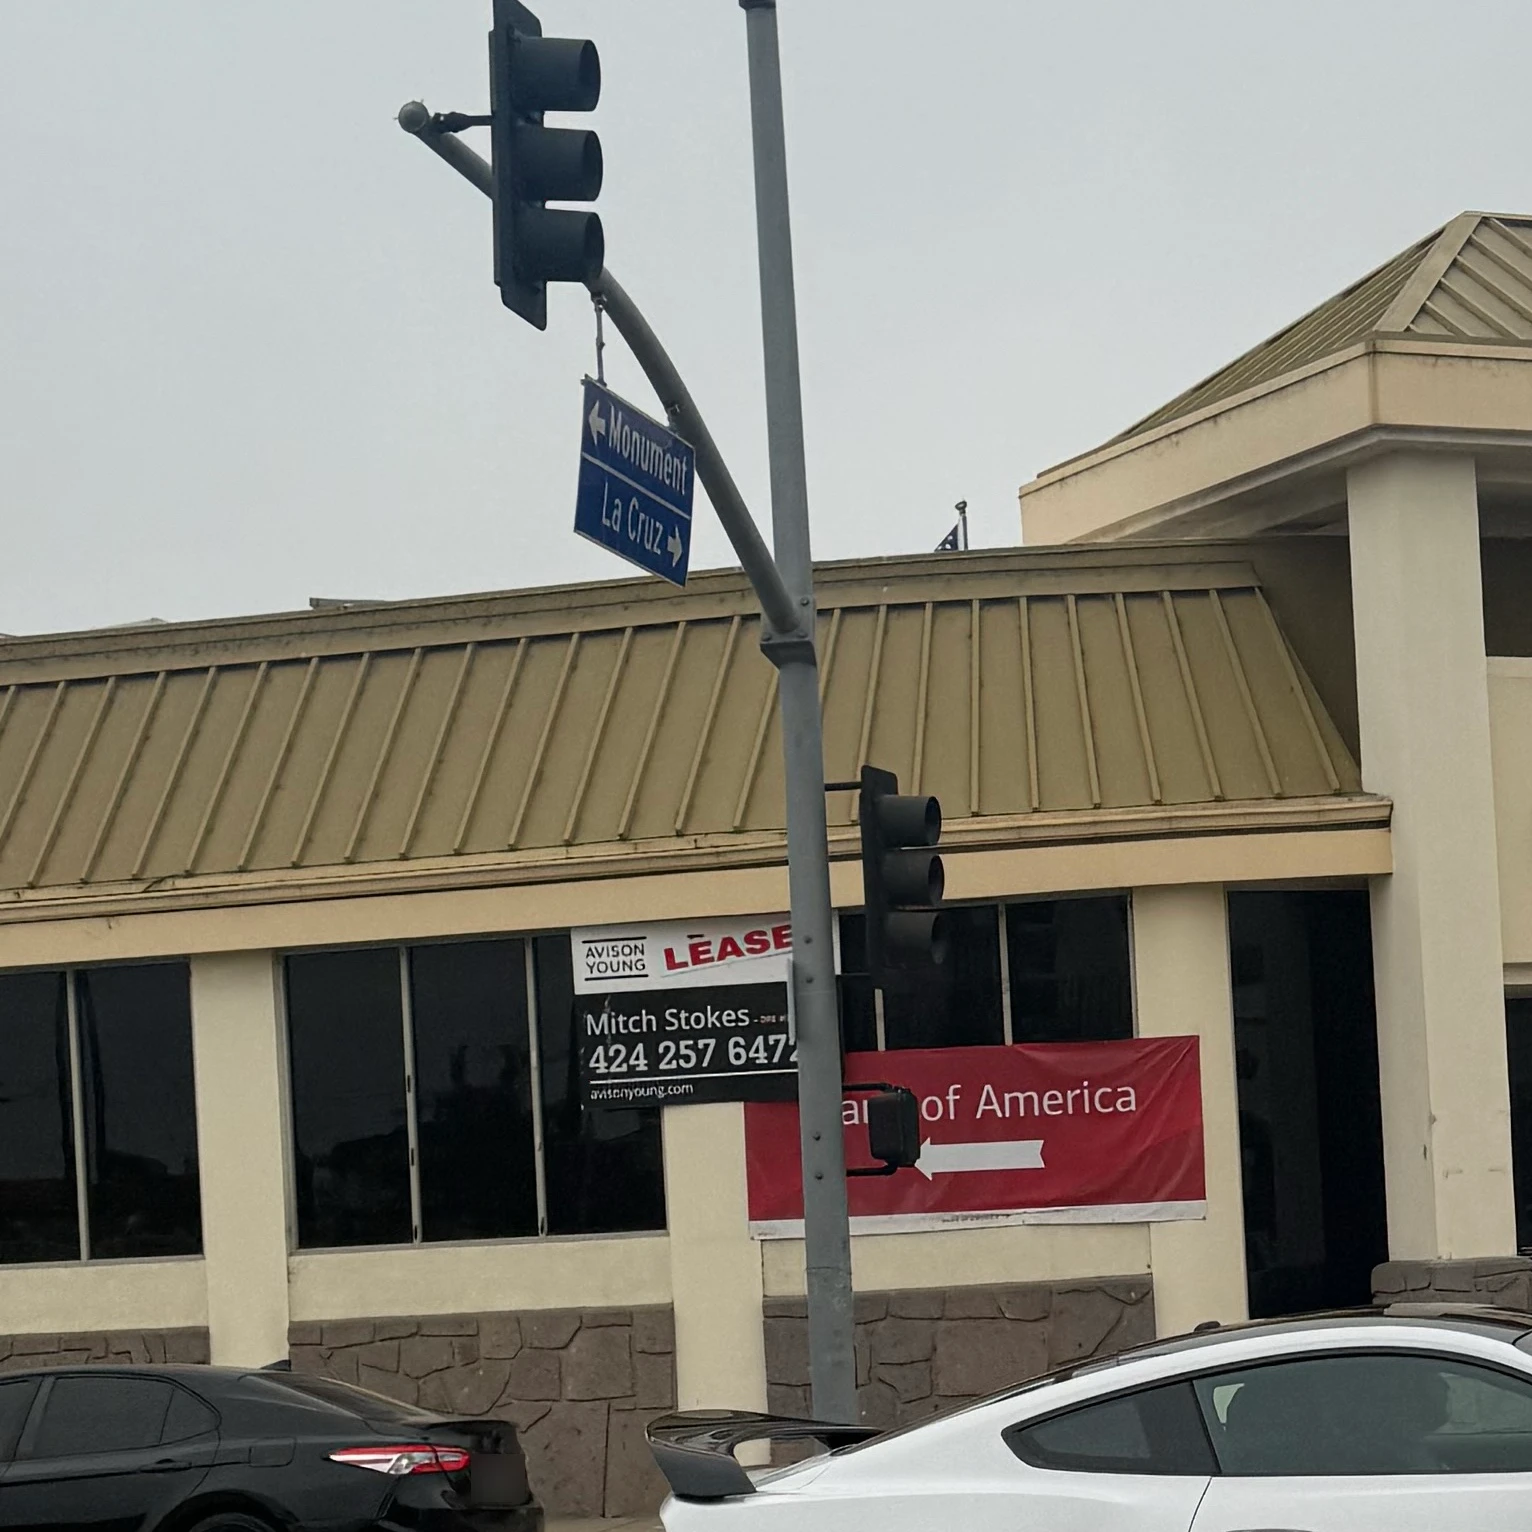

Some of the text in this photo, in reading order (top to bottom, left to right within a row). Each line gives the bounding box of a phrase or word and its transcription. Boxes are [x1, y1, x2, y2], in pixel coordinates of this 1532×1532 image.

[608, 402, 687, 495] Monument
[602, 481, 664, 555] La Cruz
[585, 943, 645, 959] AVISON
[663, 924, 793, 971] LEASE
[585, 958, 646, 975] YOUNG
[586, 1009, 657, 1036] Mitch
[664, 1005, 750, 1031] Stokes
[588, 1042, 648, 1074] 424
[658, 1038, 717, 1070] 257
[590, 1084, 694, 1101] avisonyoung.com
[921, 1080, 1137, 1122] of America
